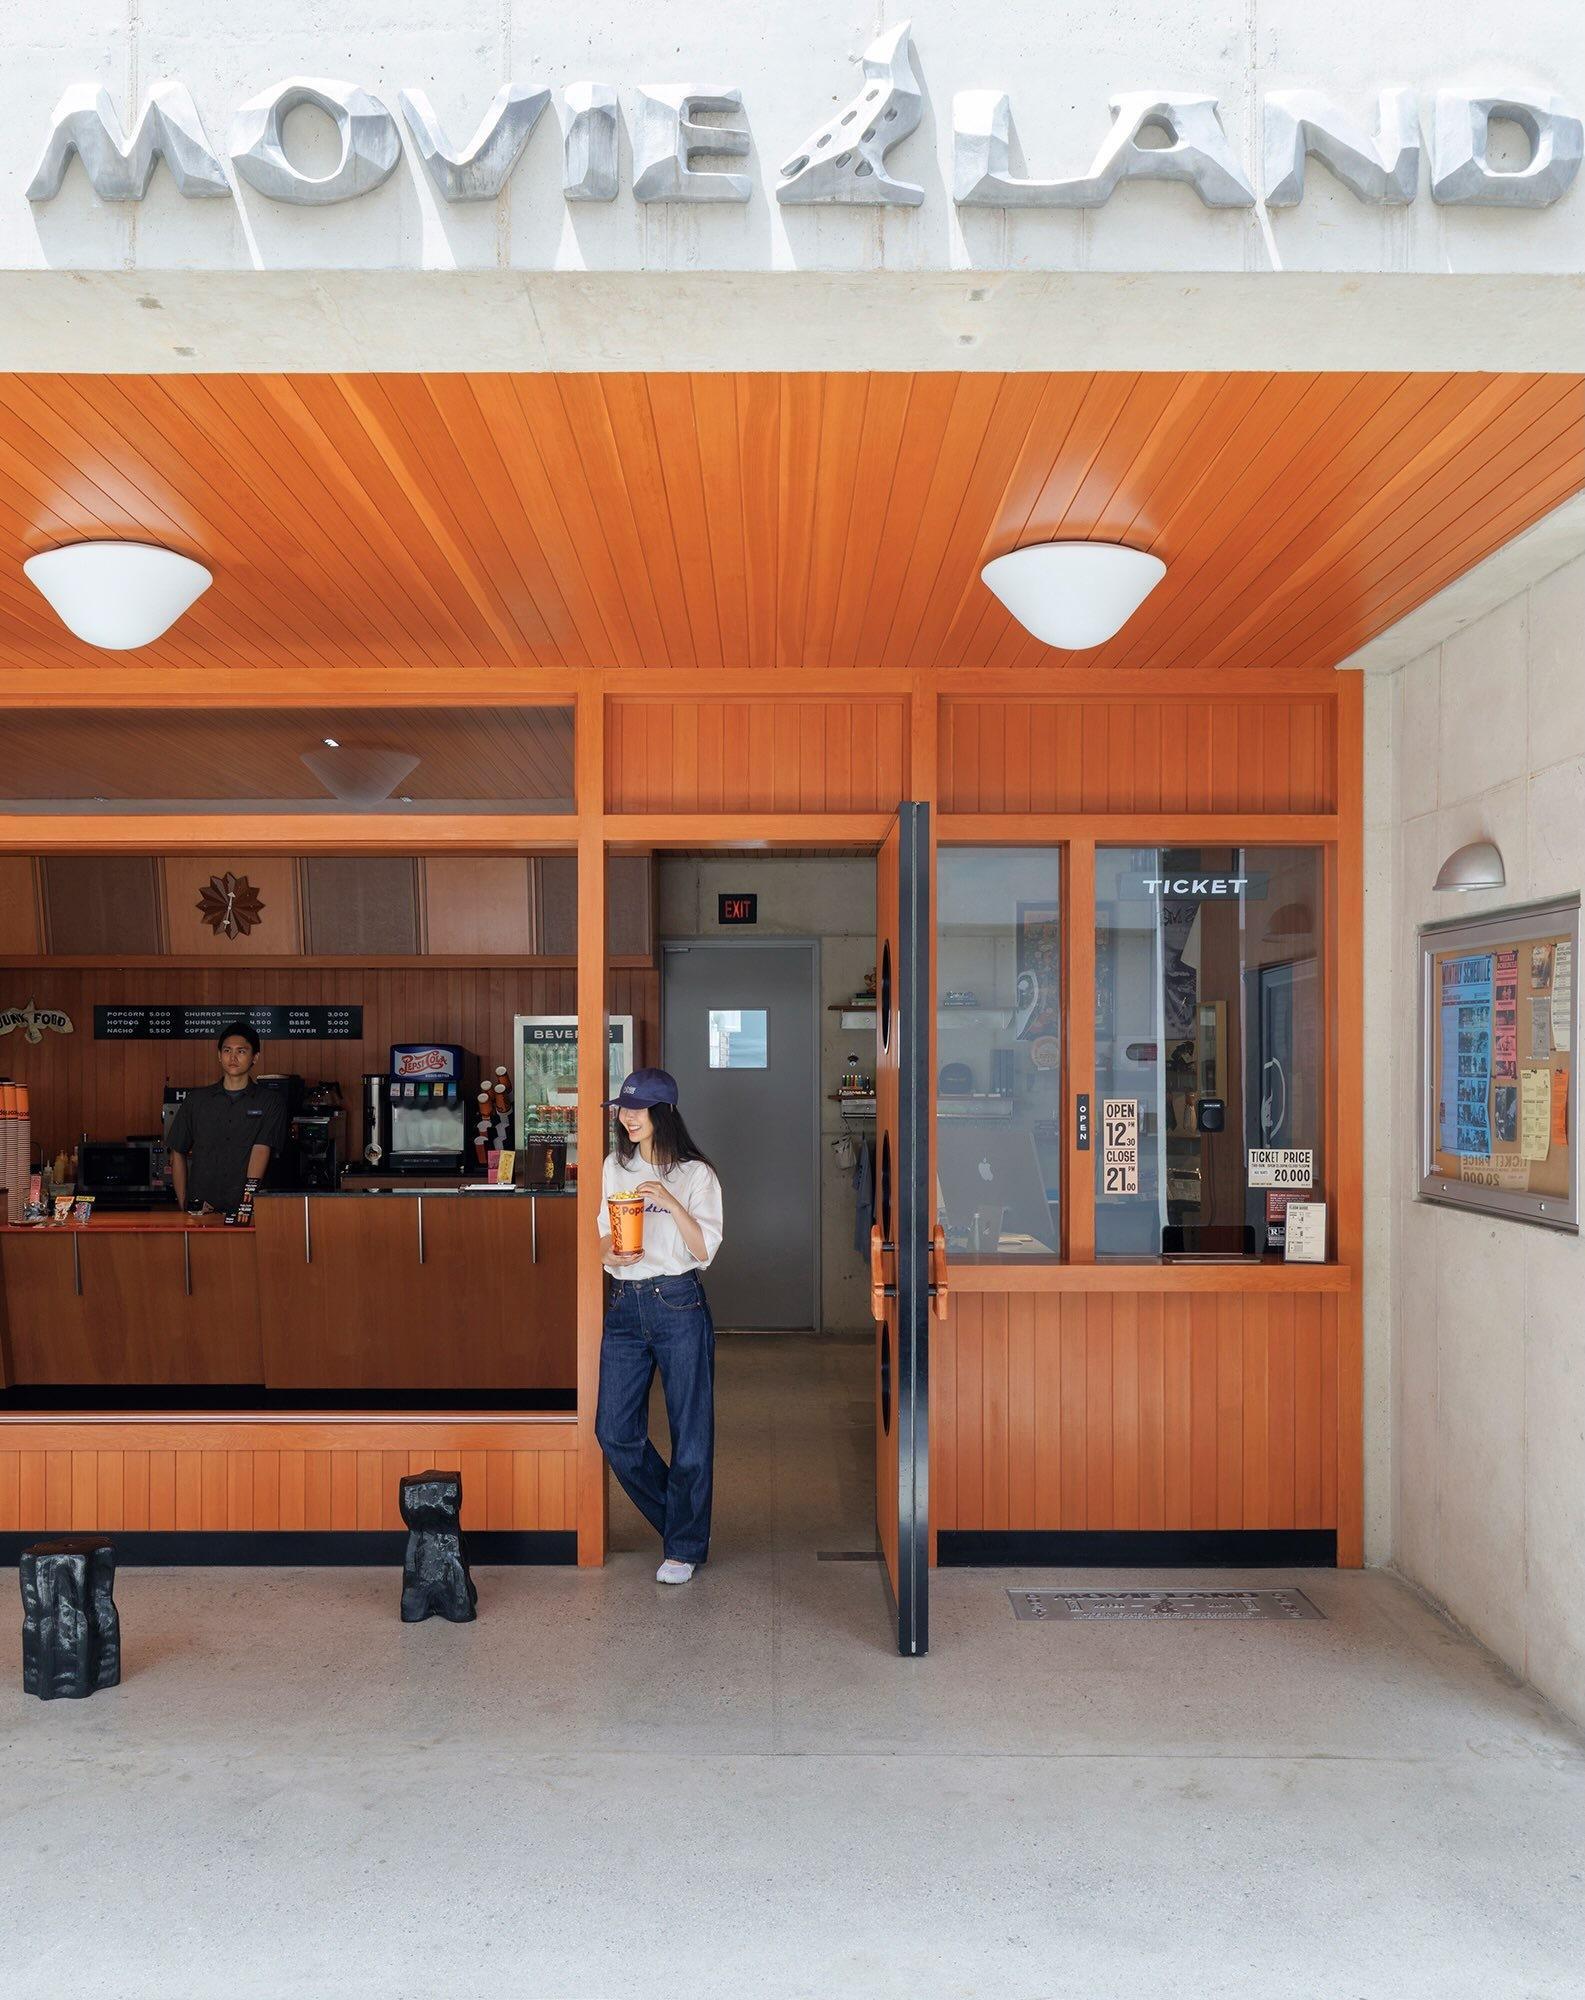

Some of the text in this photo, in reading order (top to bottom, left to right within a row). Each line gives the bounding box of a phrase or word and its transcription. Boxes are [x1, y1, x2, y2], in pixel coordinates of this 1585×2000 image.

[25, 75, 1583, 208] MOVIE LAND
[1142, 879, 1248, 894] TICKET
[724, 900, 751, 918] EXIT
[33, 1013, 67, 1028] FOOD
[1107, 1104, 1135, 1118] OPEN
[1079, 1105, 1087, 1140] OPEN
[1106, 1122, 1127, 1146] 12
[1126, 1138, 1136, 1146] 30
[1106, 1150, 1135, 1162] CLOSE
[1251, 1151, 1311, 1163] TICKET PRICE
[1106, 1167, 1126, 1191] 21
[1126, 1183, 1136, 1191] 00
[1274, 1169, 1311, 1182] 20,000
